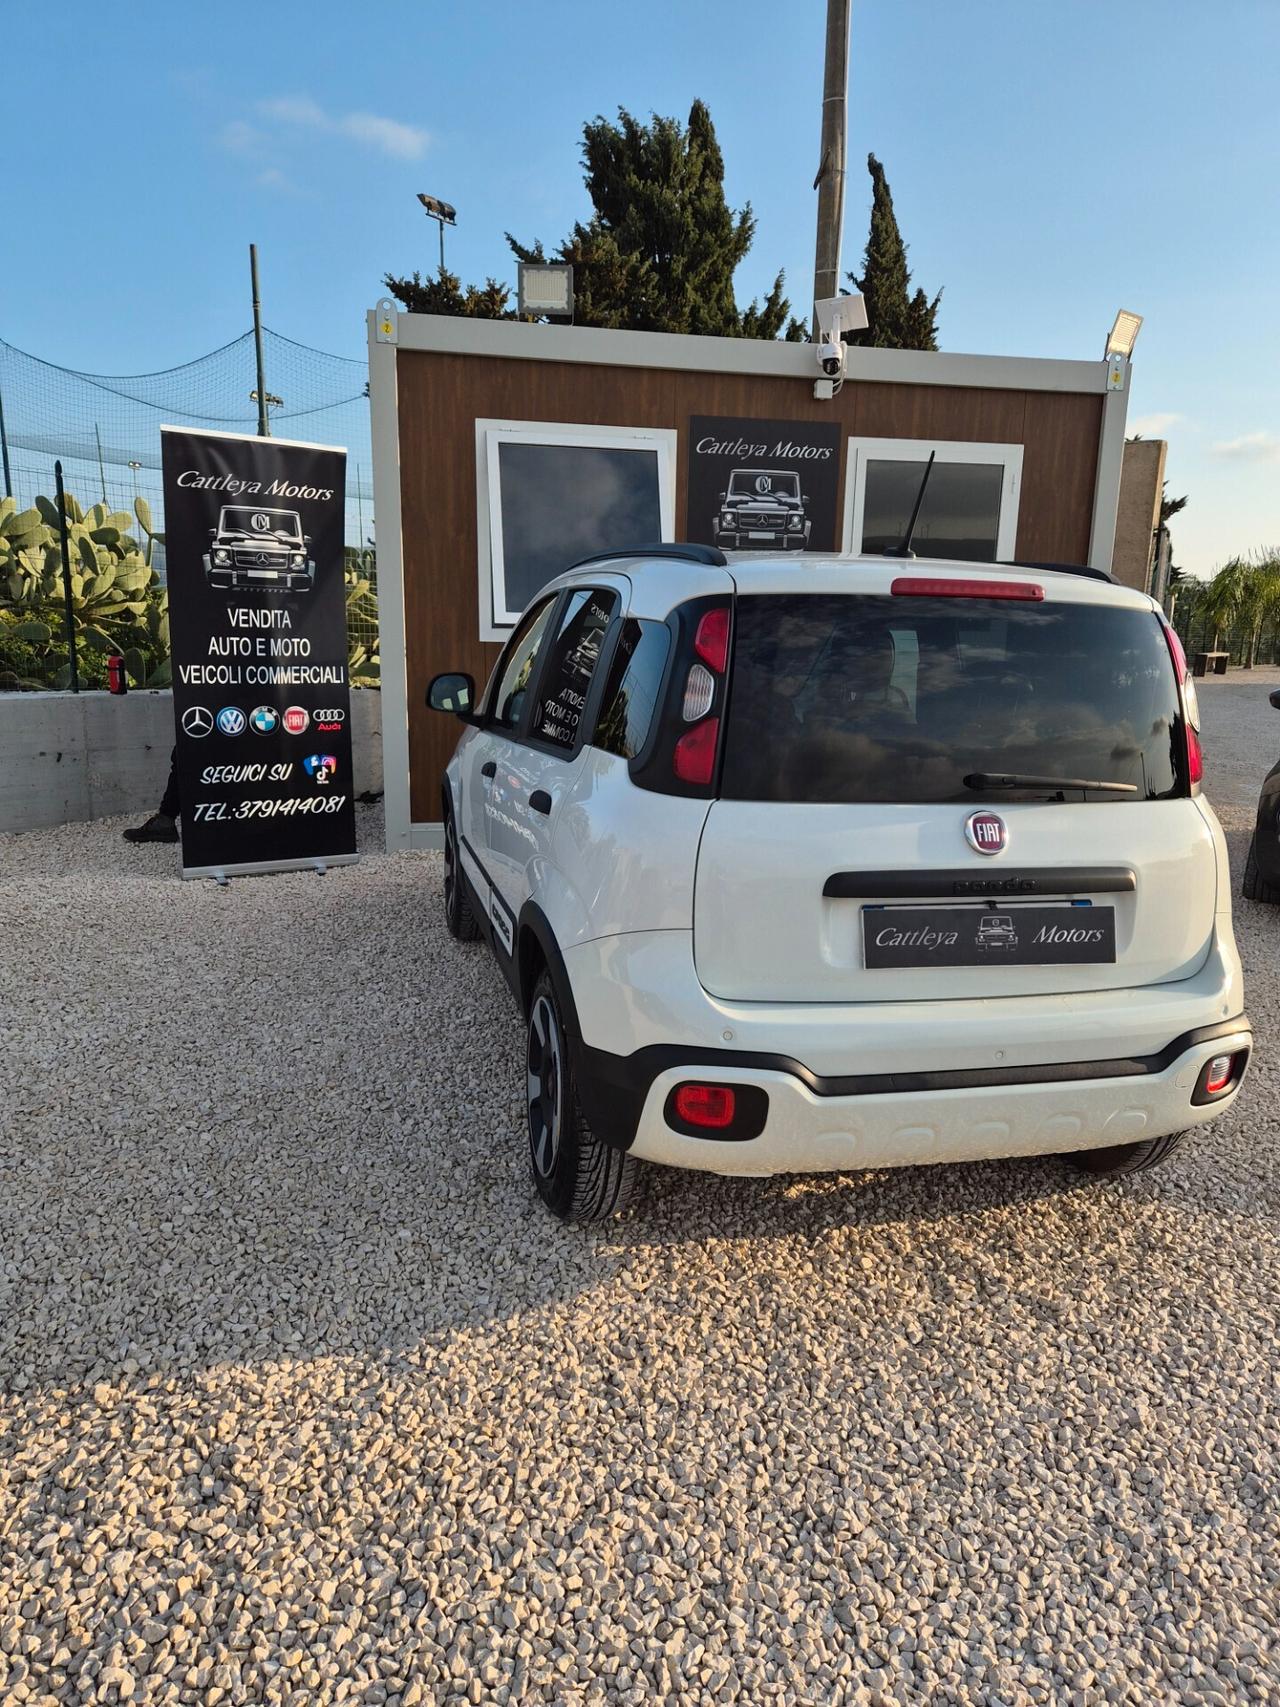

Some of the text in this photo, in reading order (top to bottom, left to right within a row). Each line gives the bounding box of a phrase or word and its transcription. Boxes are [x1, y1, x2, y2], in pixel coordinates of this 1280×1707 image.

[696, 437, 833, 460] Cattleya Motors
[177, 470, 335, 501] Cattleya Motors
[227, 608, 292, 629] VENDITA
[208, 636, 311, 657] AUTO E MOTO
[179, 665, 344, 685] VEICOLI COMMERCIALI
[288, 714, 305, 727] FIAT
[317, 722, 342, 731] Audi
[200, 763, 294, 785] SEGUICI SU
[976, 822, 1000, 843] FIAT
[875, 924, 1104, 950] Cattleya Motors
